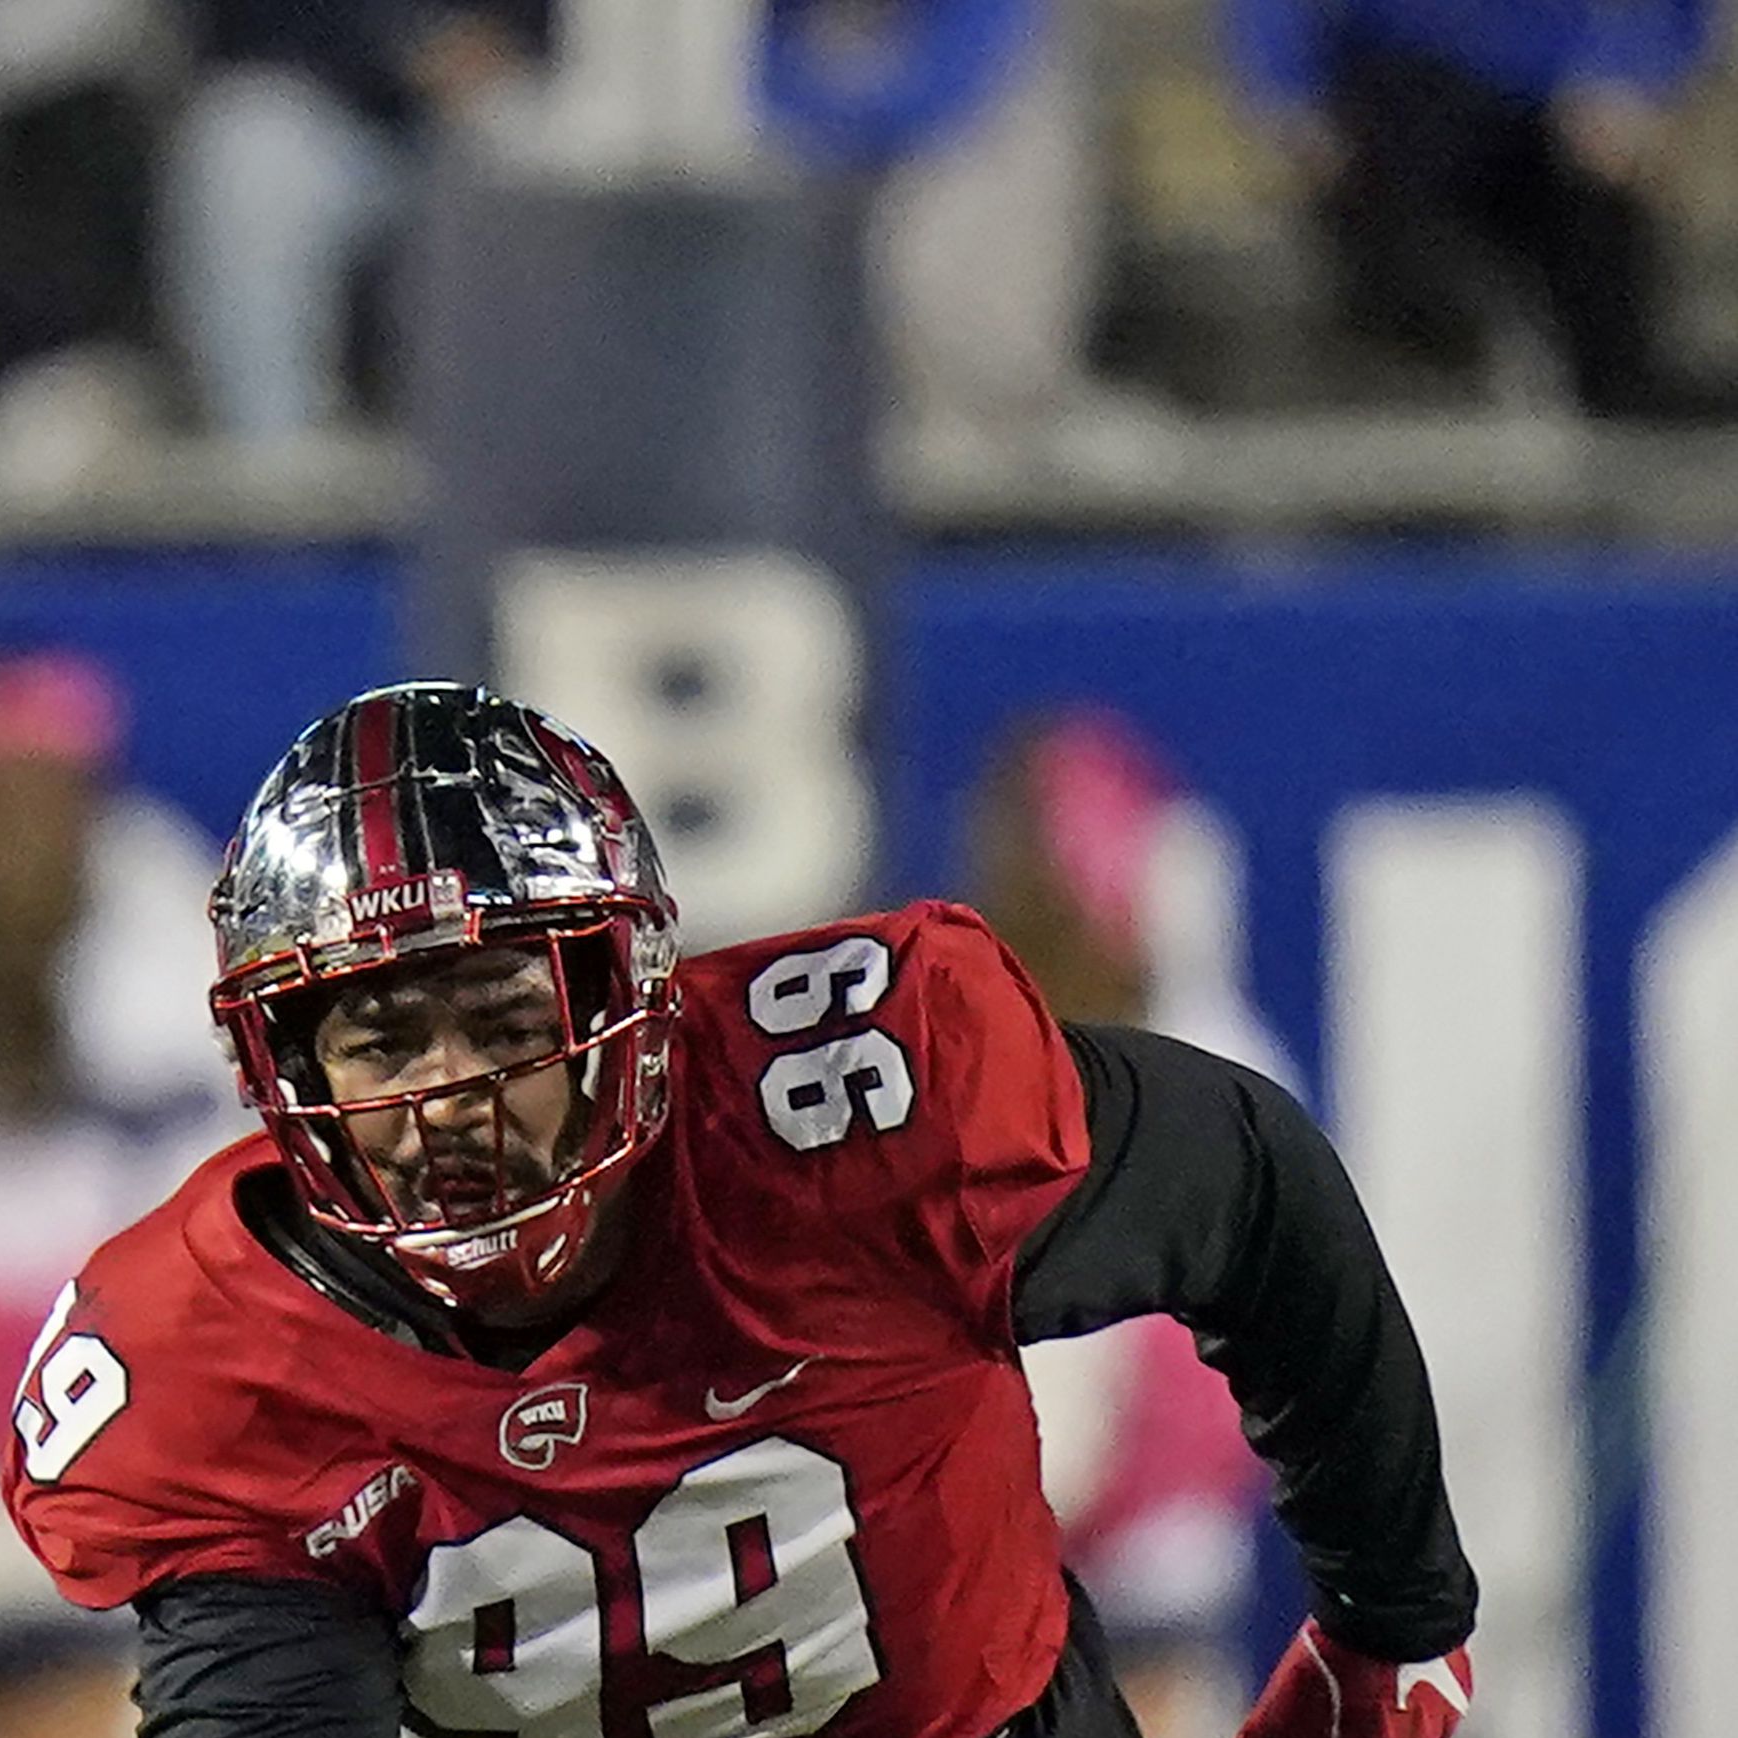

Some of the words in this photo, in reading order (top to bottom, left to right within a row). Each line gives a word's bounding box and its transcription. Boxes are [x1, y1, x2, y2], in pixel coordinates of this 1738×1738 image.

[498, 550, 871, 955] B
[352, 880, 425, 922] WKU
[748, 936, 915, 1152] 99
